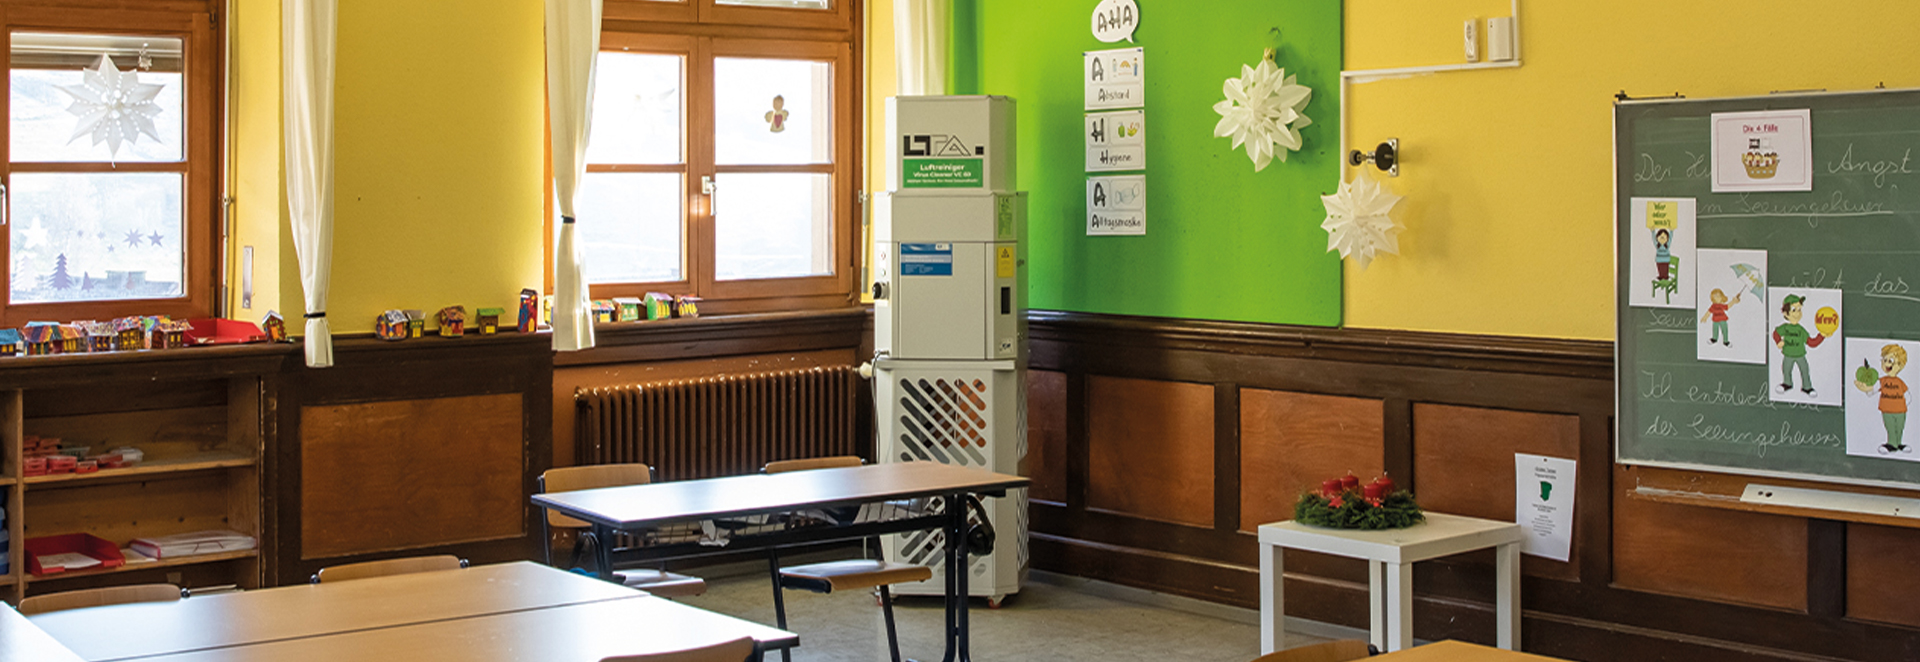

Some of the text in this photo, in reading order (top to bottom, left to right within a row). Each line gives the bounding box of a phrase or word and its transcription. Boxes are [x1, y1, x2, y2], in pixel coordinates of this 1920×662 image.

[1097, 4, 1133, 33] AHA
[1092, 56, 1104, 82] A
[1098, 88, 1130, 102] Abstand
[1091, 117, 1105, 143] H
[1743, 124, 1754, 133] Die
[920, 163, 965, 172] Luftreiniger
[1099, 149, 1132, 166] Hygiene
[1634, 152, 1672, 183] Der
[1828, 142, 1912, 189] Angst
[1093, 181, 1106, 207] A
[1091, 213, 1141, 230] Alltagsmaske
[1864, 272, 1910, 294] das
[1641, 369, 1676, 403] Ich
[1645, 415, 1679, 437] des
